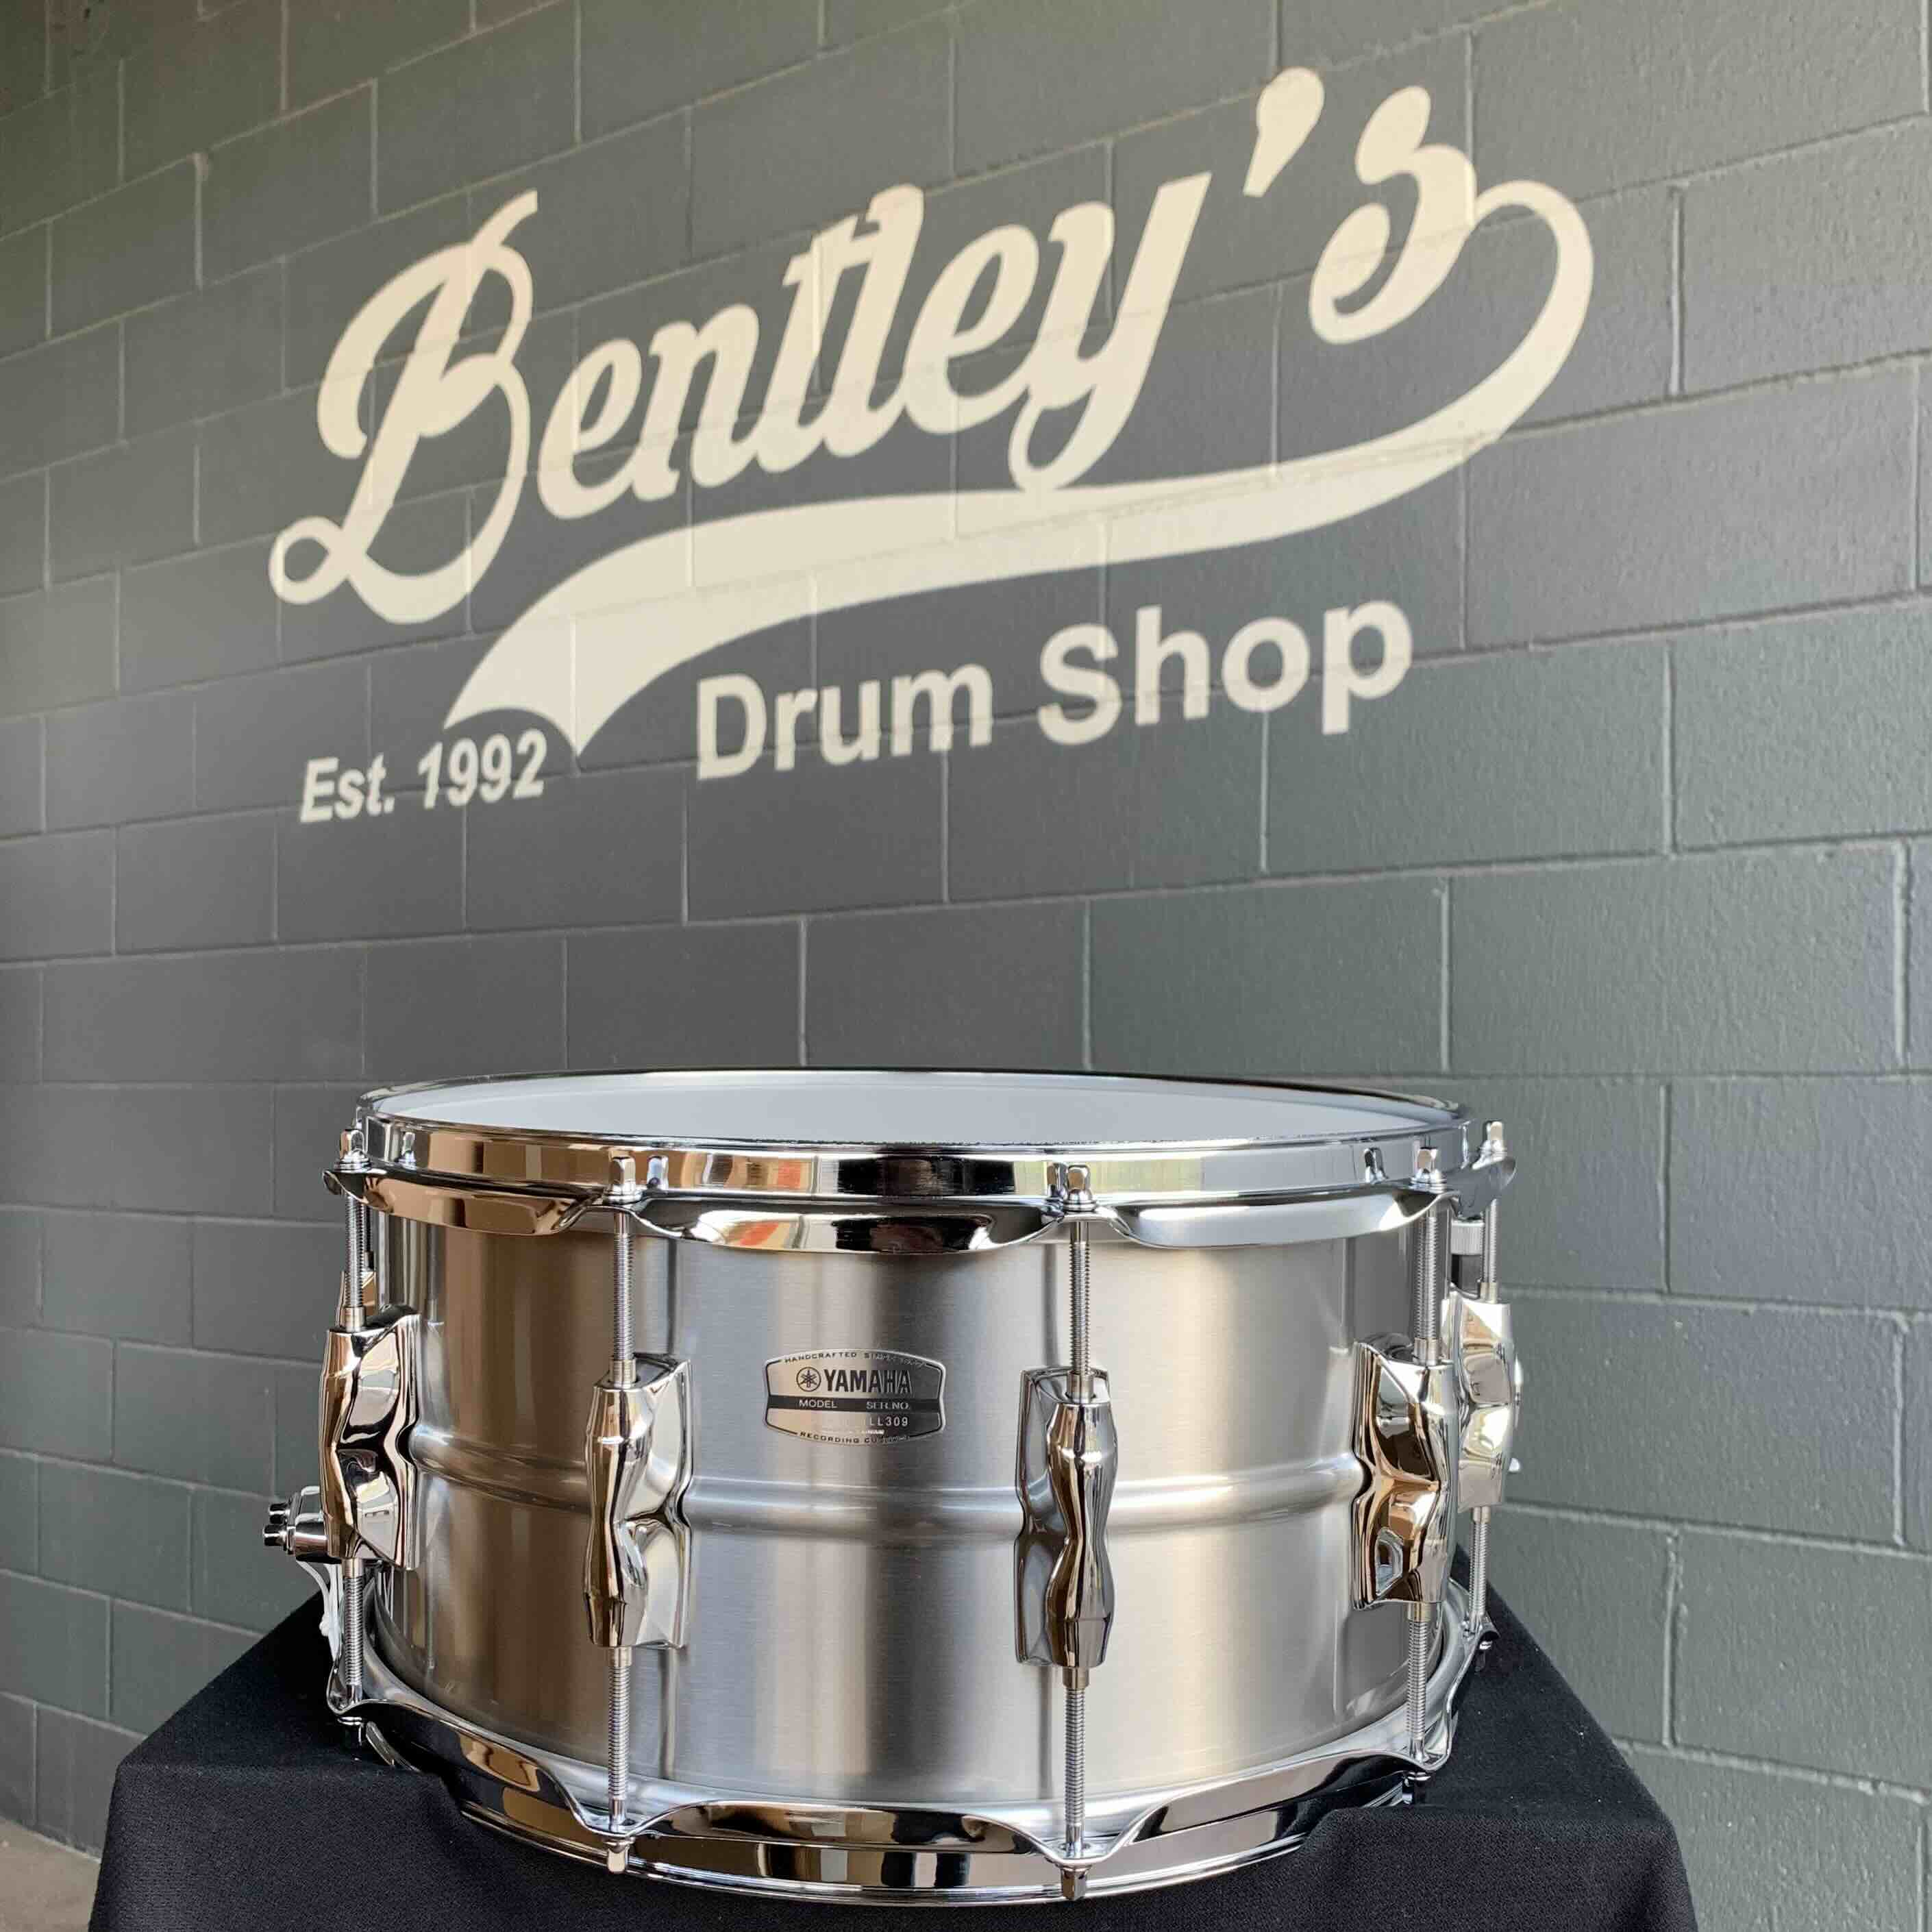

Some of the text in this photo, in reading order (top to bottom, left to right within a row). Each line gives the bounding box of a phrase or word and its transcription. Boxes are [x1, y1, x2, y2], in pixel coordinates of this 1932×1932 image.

[269, 66, 1595, 623] Bentley's
[697, 601, 1413, 780] Drum Shop
[300, 730, 547, 822] Est. 1992
[784, 1352, 856, 1363] HANDCRAFTED
[823, 1370, 912, 1394] YAMAHA
[798, 1399, 837, 1409] MODEL
[800, 1431, 860, 1444] RECORDING
